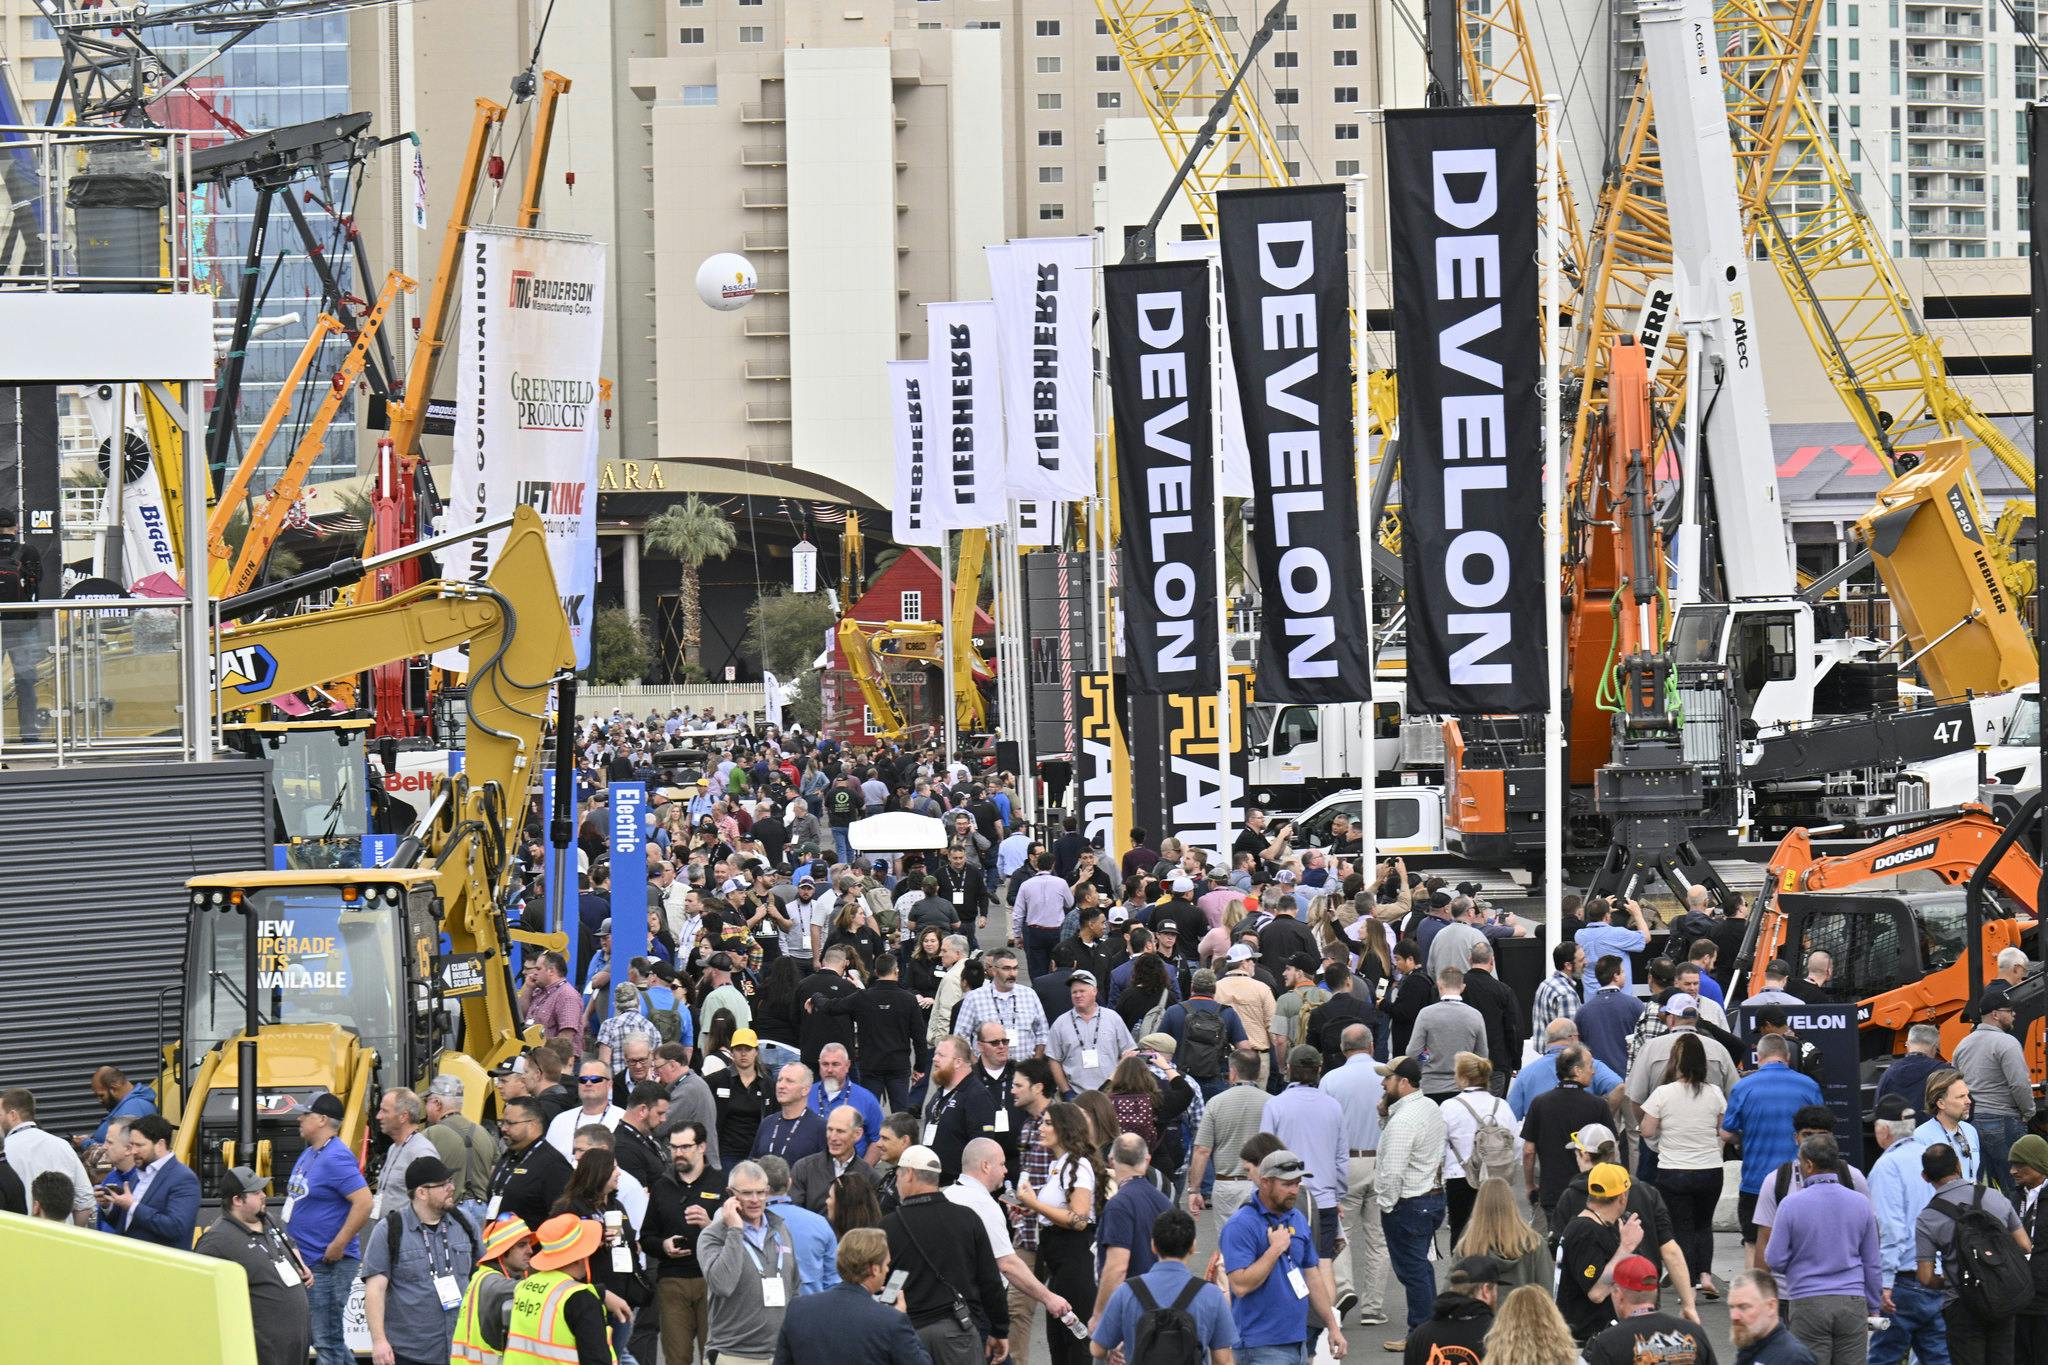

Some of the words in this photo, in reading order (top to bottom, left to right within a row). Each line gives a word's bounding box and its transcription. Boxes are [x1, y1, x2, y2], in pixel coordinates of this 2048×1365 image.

[1640, 290, 1673, 369] HERR
[1733, 318, 1749, 369] Altec
[511, 371, 594, 404] GREENFIELD
[517, 402, 587, 430] PRODUCTS
[1432, 148, 1513, 686] DEVELON
[1256, 221, 1339, 682] DEVELON
[599, 462, 666, 490] ARA
[1136, 290, 1197, 673] DEVELON
[31, 510, 54, 528] CAT
[1973, 550, 2006, 615] LIEBHERR
[1933, 719, 1963, 744] 47
[616, 788, 641, 853] Electric
[1875, 843, 1935, 870] DOOSAN
[1750, 1014, 1846, 1030] VELON
